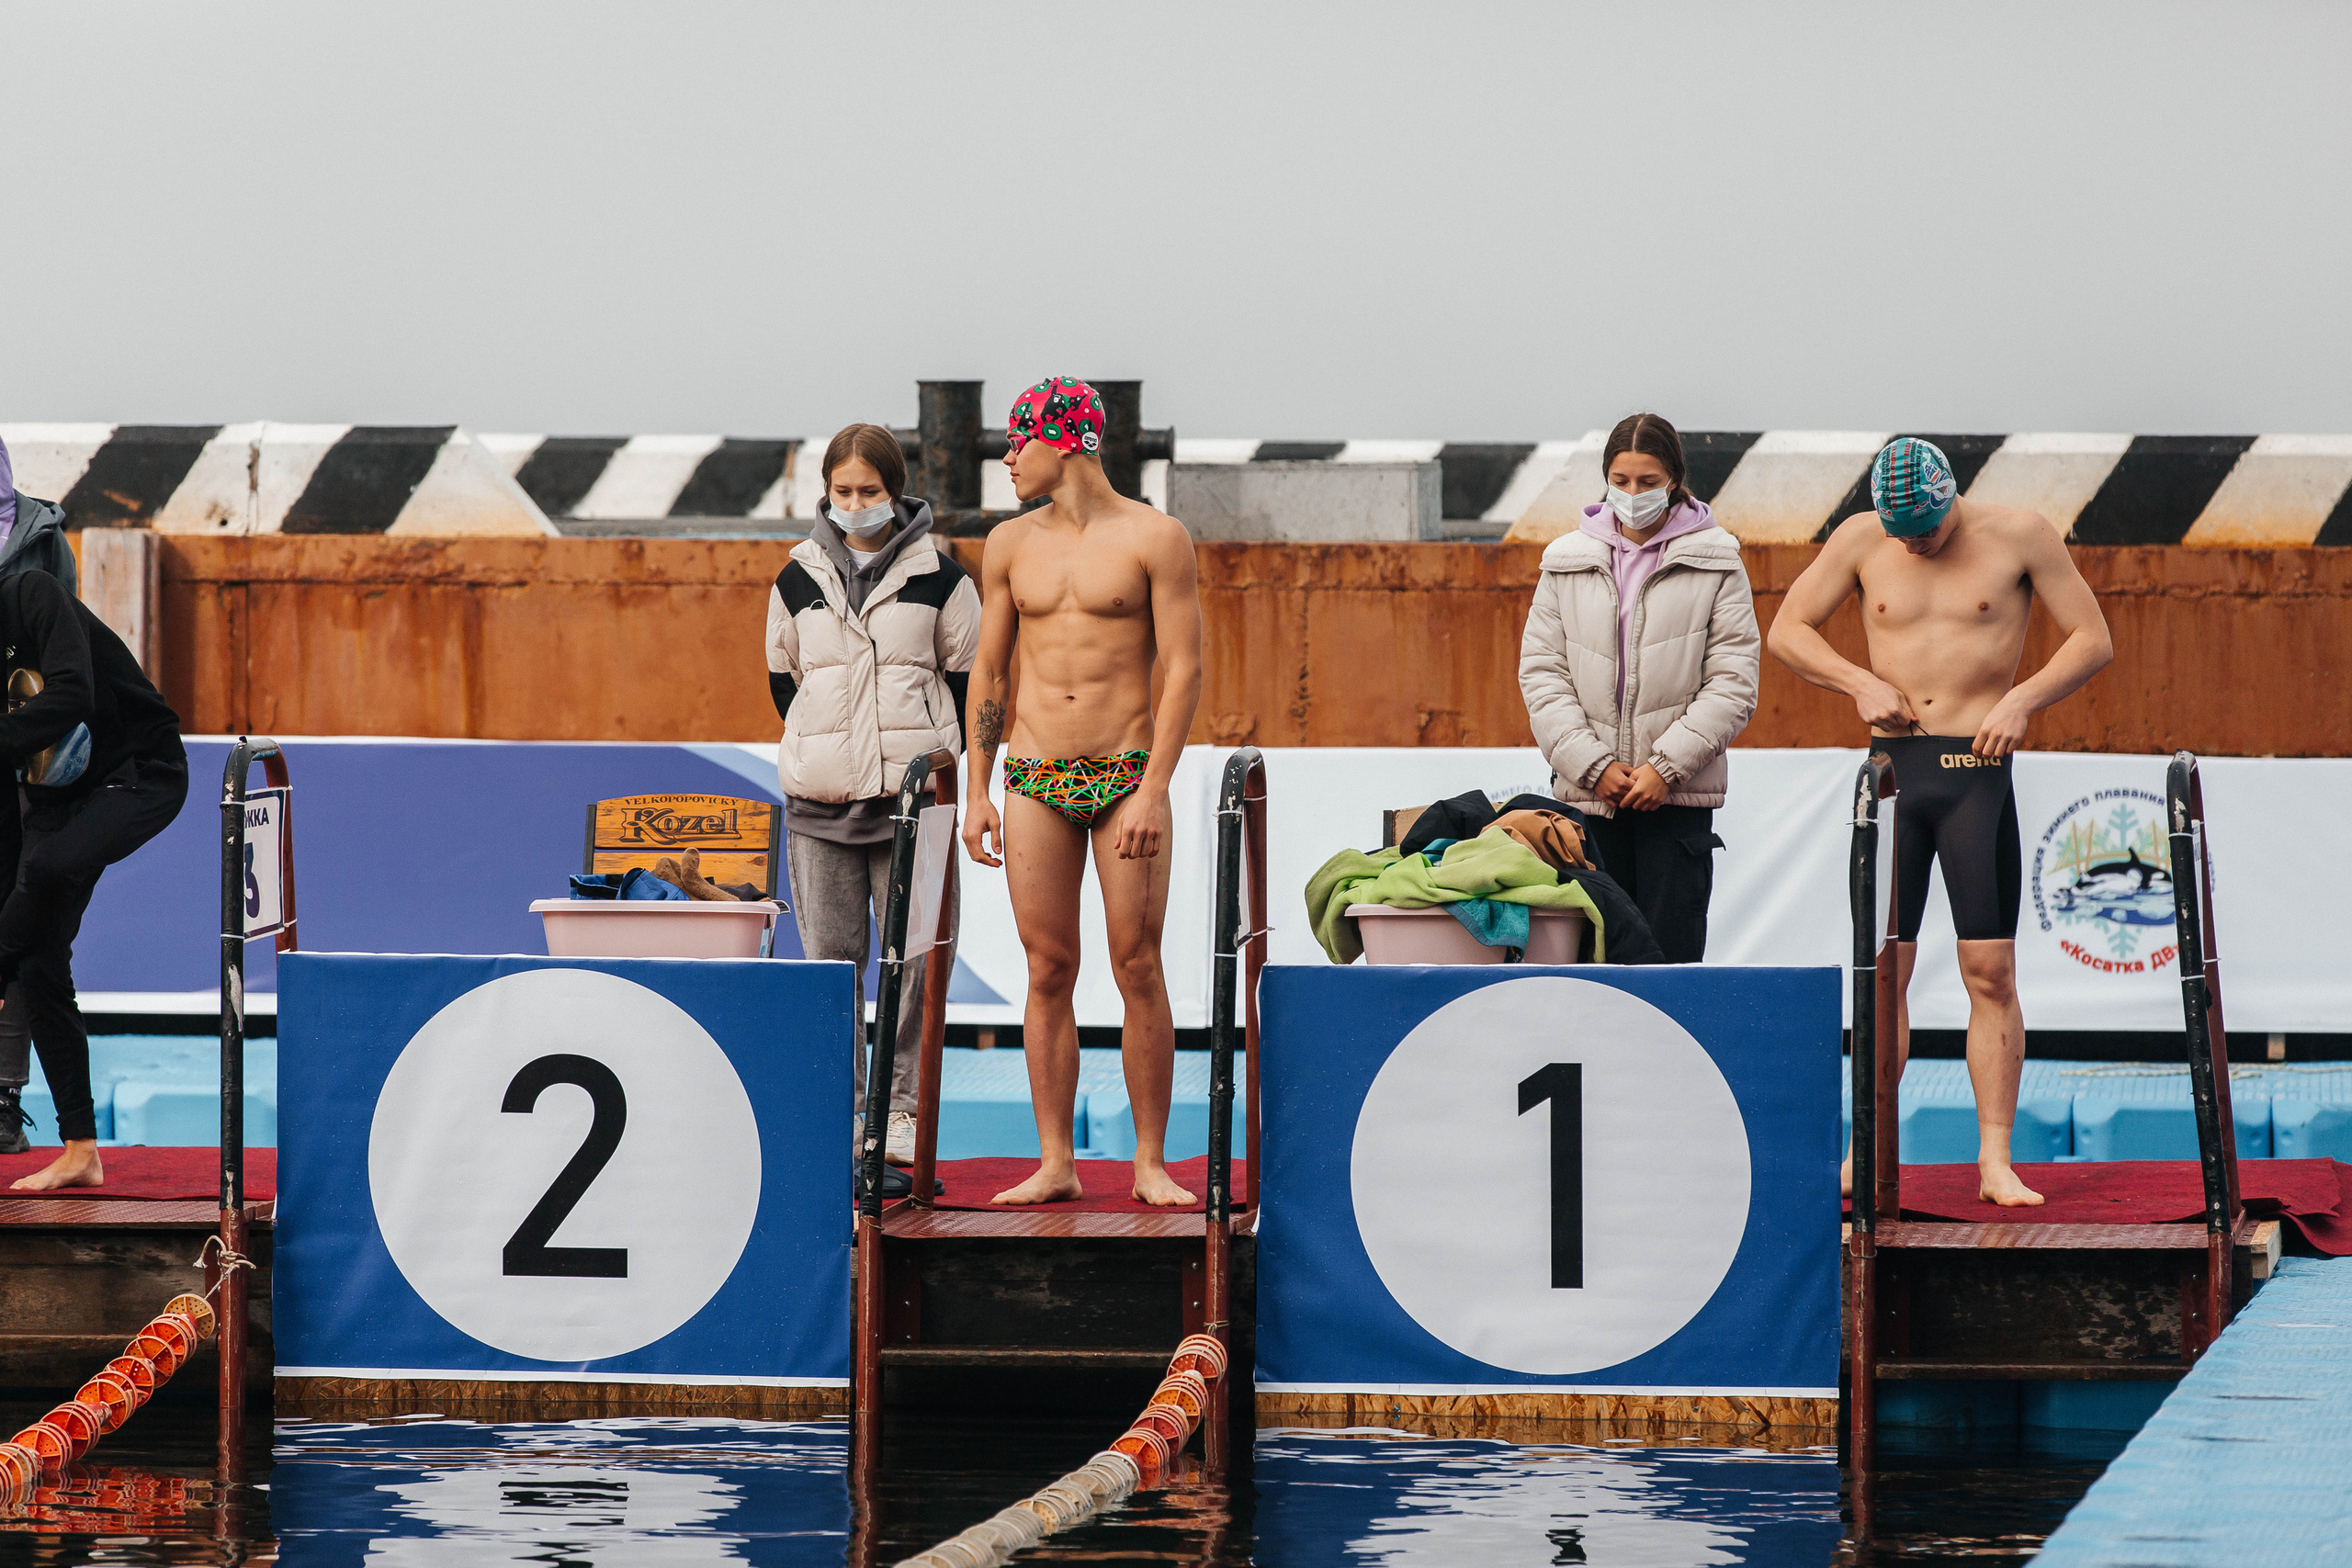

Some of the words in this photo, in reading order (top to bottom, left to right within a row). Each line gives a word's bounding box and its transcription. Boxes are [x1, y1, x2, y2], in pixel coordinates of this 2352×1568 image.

[619, 807, 743, 846] Kozel
[501, 1054, 628, 1279] 2
[1518, 1062, 1584, 1289] 1
